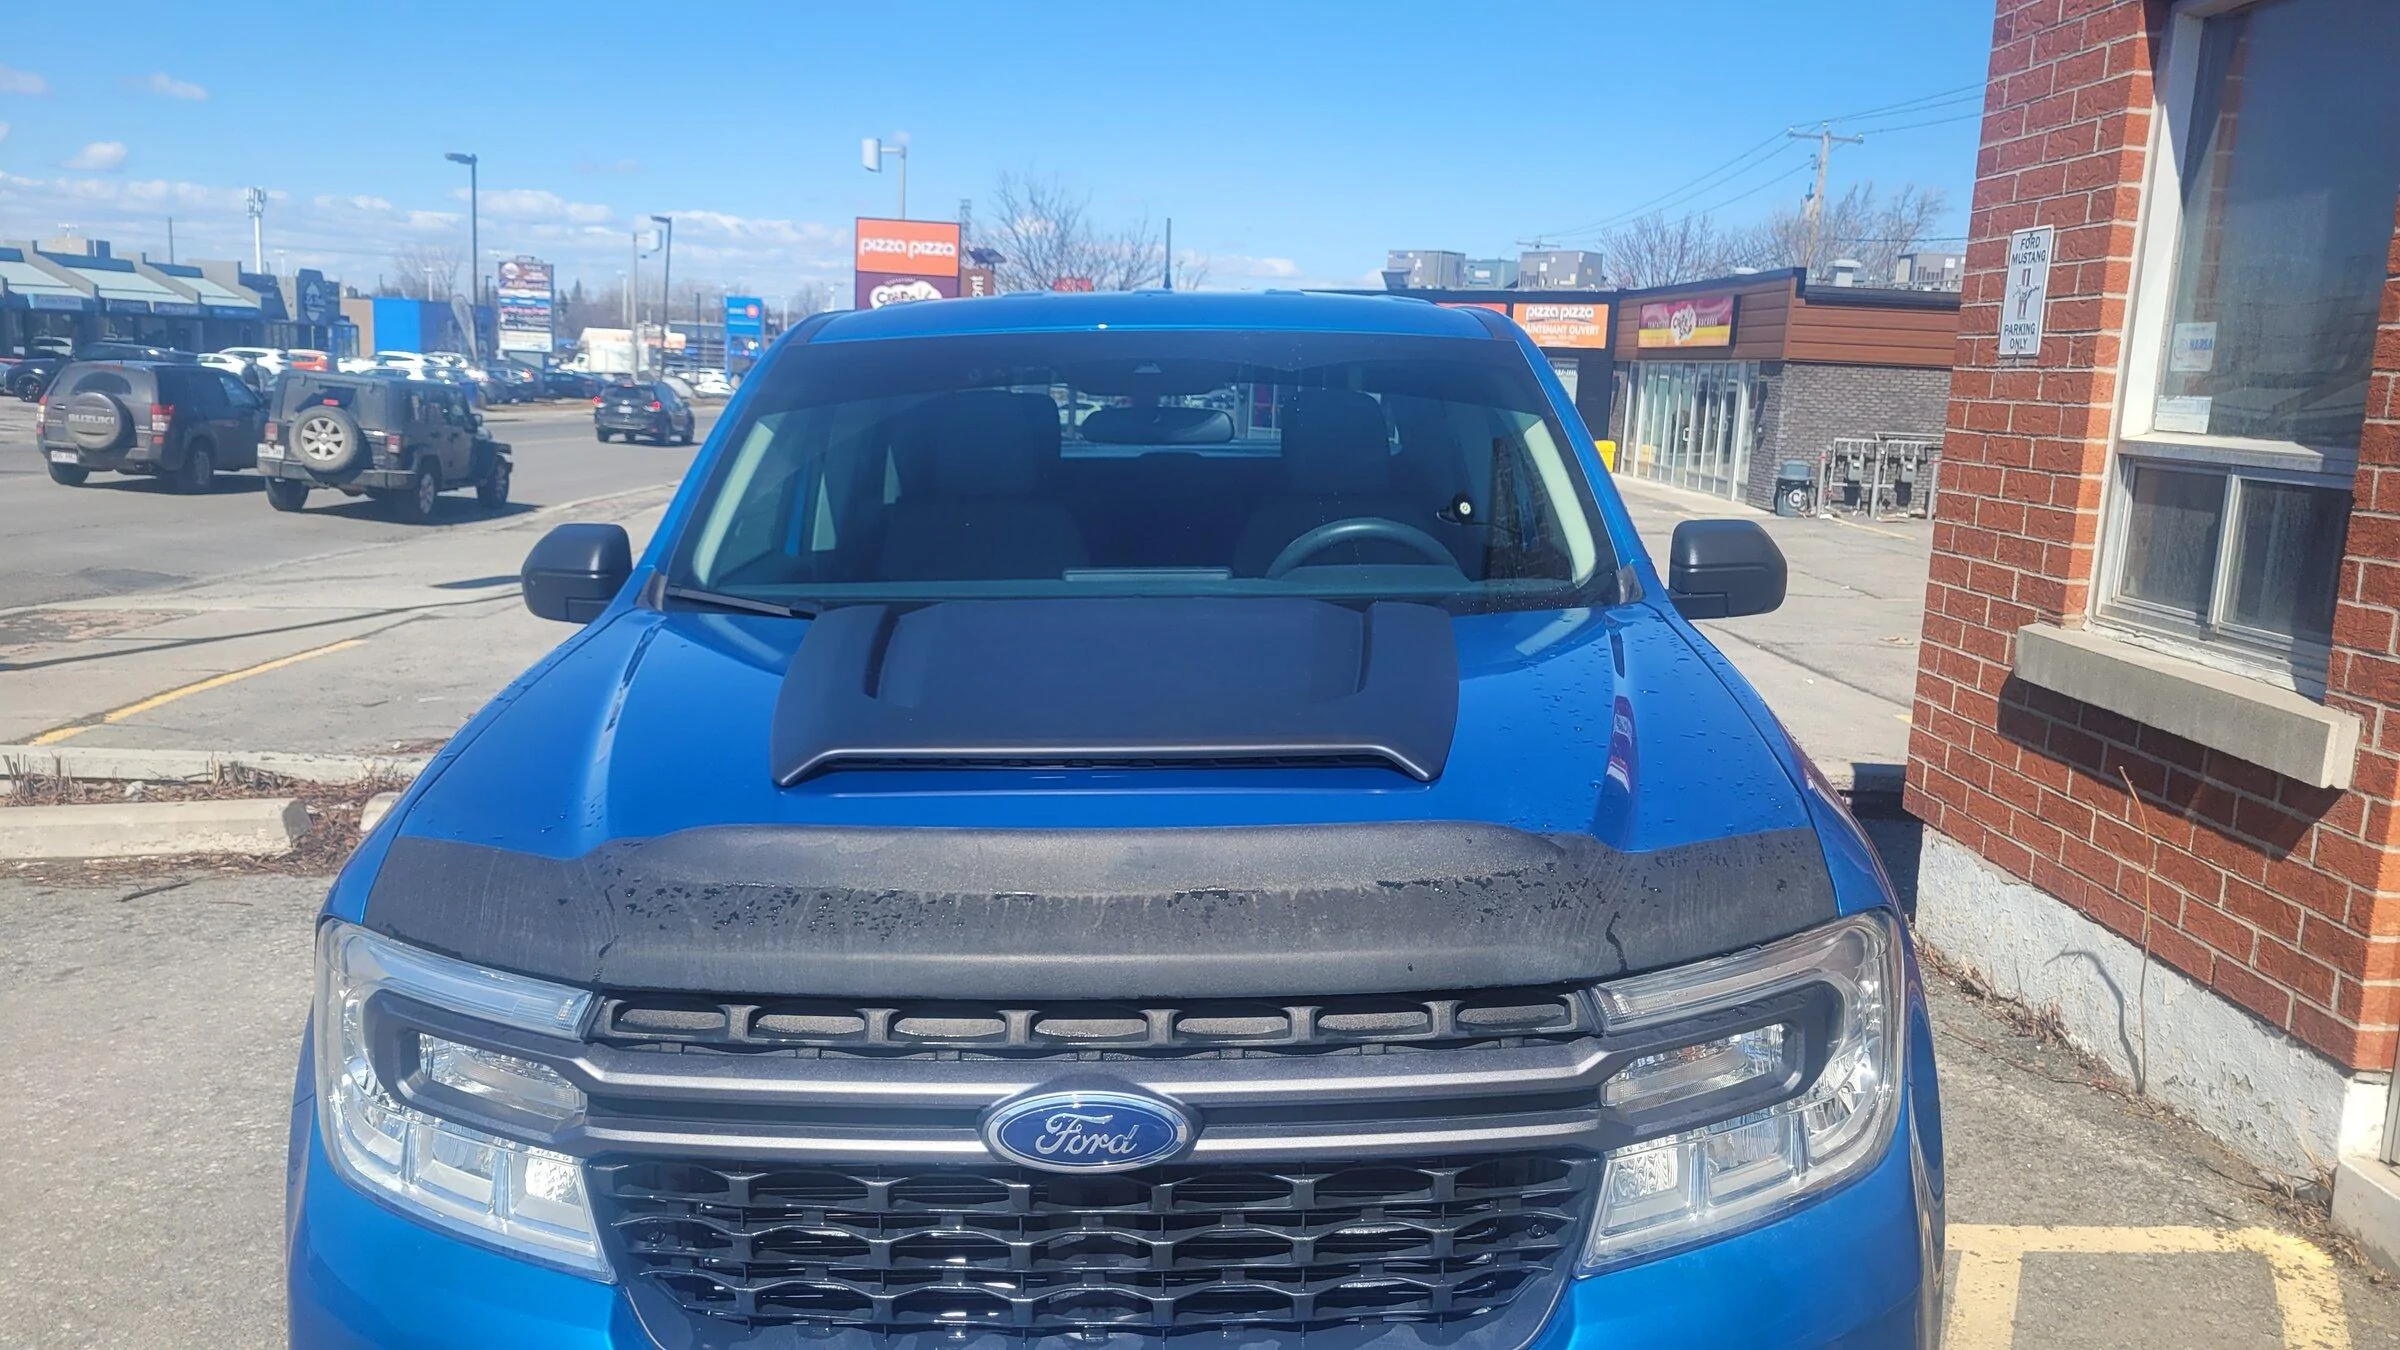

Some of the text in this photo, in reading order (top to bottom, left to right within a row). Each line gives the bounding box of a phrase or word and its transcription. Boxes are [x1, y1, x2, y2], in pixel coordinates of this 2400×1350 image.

[861, 239, 955, 258] pizza pizza
[2021, 236, 2040, 249] FORD
[2012, 250, 2046, 264] MUSTANG
[1526, 306, 1594, 321] pizza pizza
[2005, 323, 2036, 335] PARKING
[2010, 338, 2028, 349] ONLY
[69, 414, 115, 425] SUZUKI
[1035, 1113, 1139, 1154] Ford
